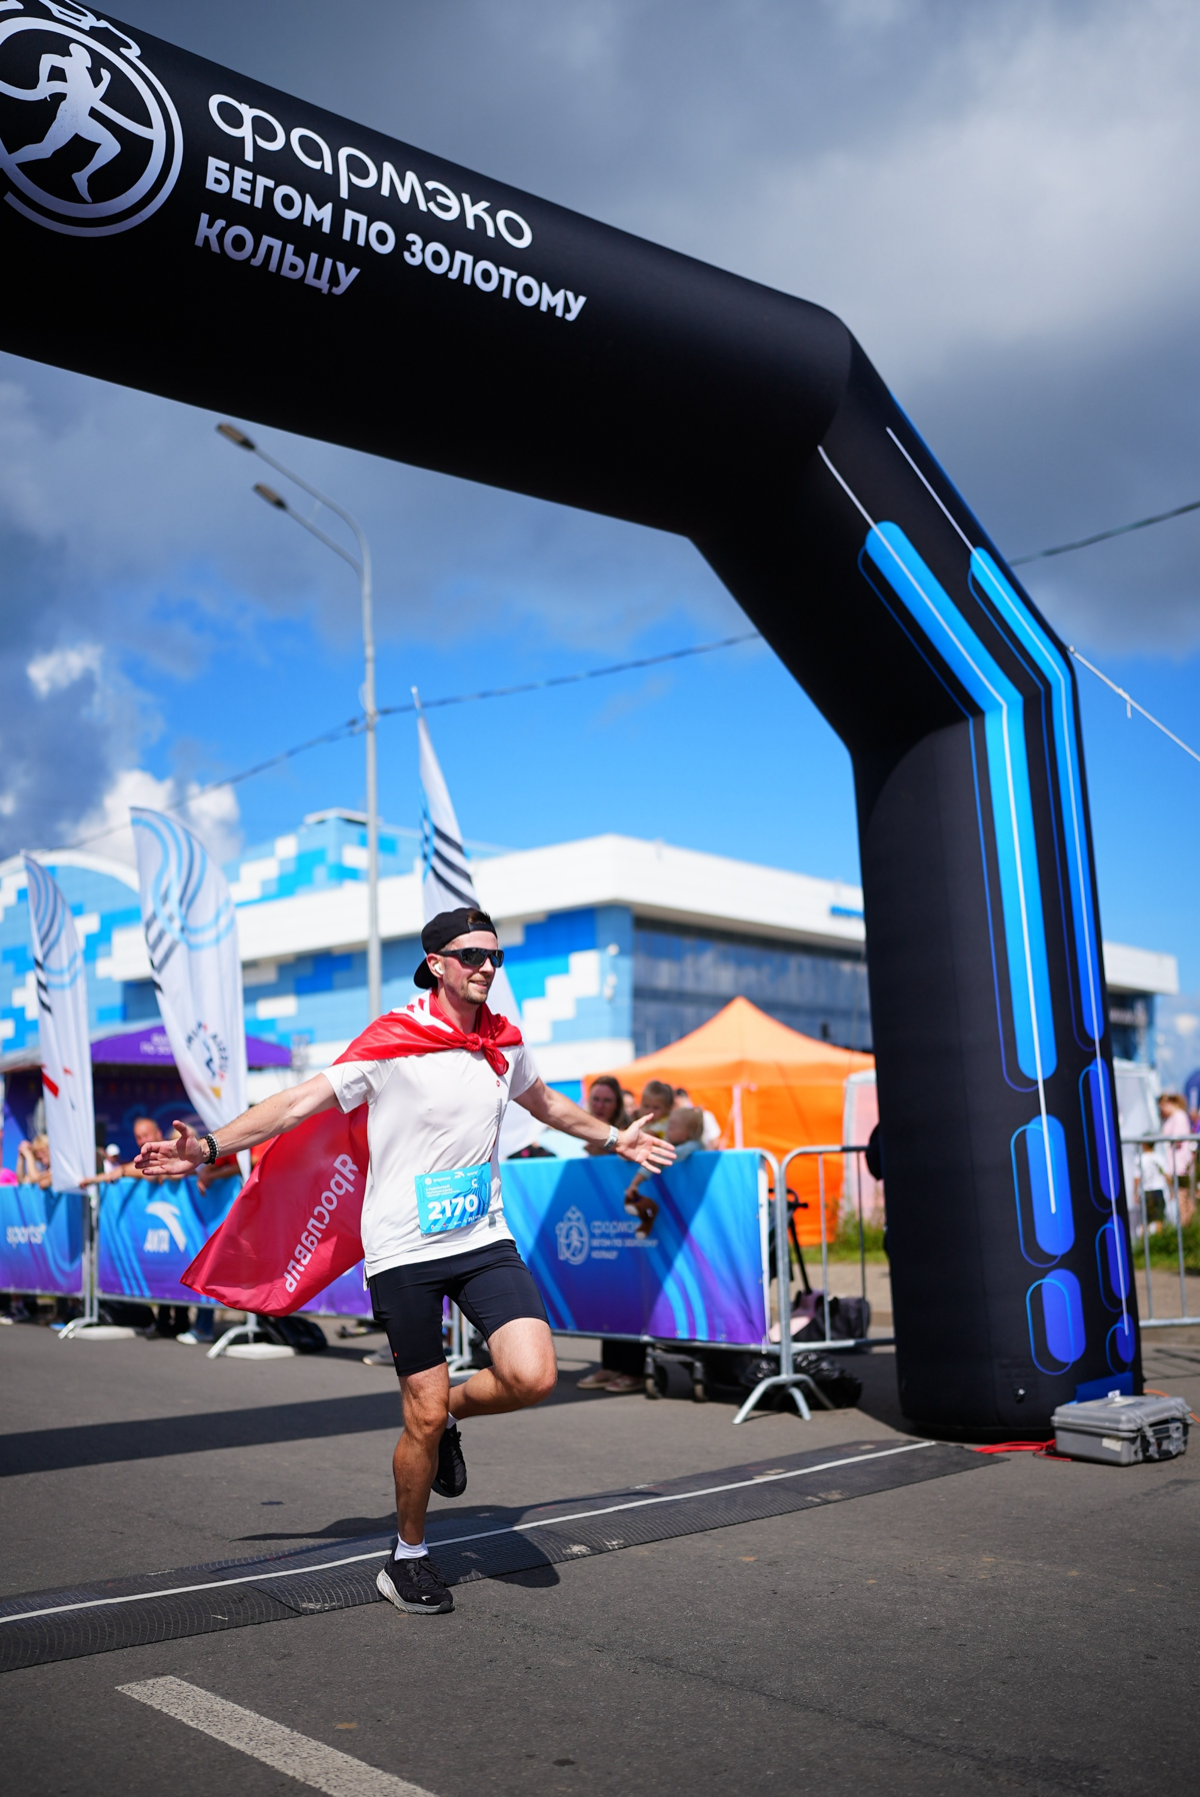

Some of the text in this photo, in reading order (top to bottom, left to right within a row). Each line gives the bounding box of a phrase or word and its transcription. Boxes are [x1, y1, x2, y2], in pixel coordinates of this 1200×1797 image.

[208, 93, 533, 249] фармэко
[195, 213, 361, 295] КОЛЬЦУ
[205, 155, 587, 322] БЕГОМ ПО ЗОЛОТОМУ
[427, 1194, 479, 1220] 2170
